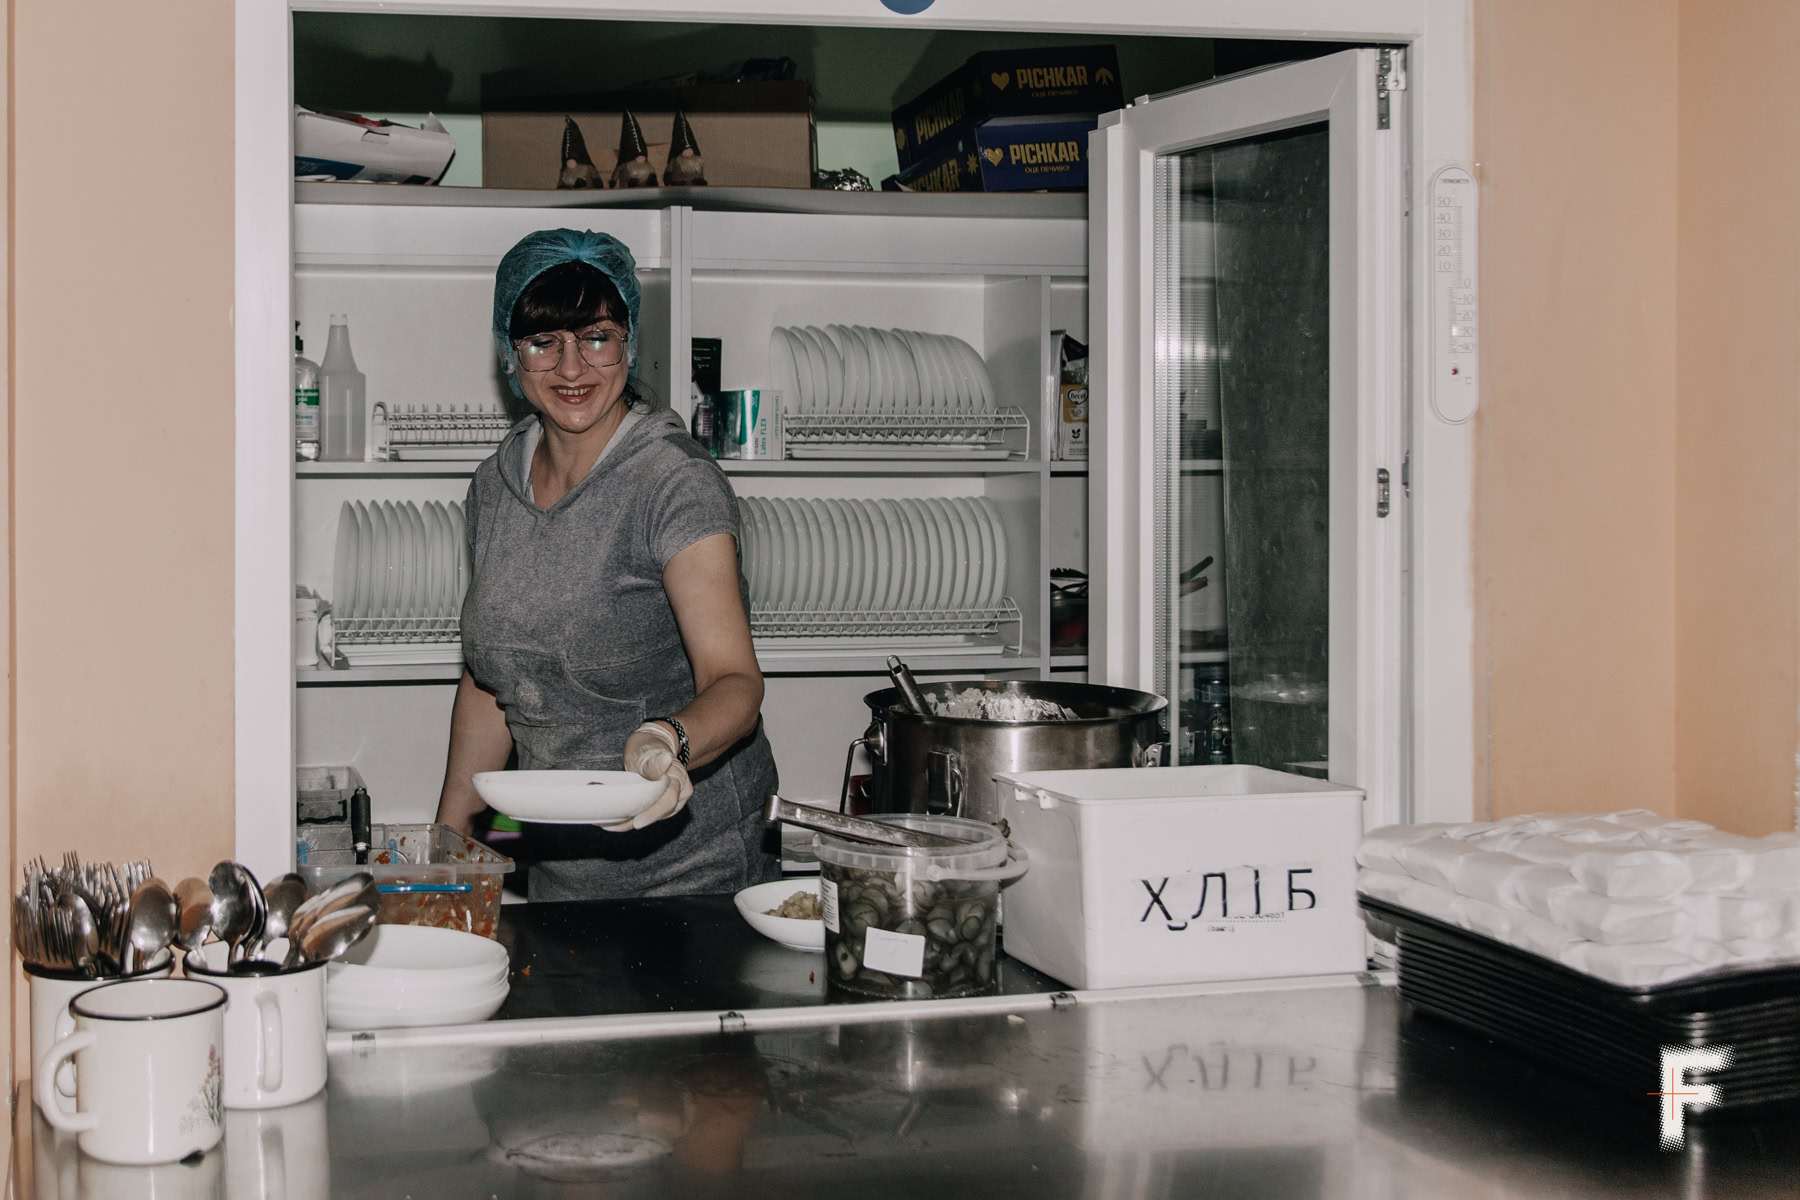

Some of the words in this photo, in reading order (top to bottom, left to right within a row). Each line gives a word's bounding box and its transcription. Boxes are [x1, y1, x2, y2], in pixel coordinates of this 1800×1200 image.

[1016, 64, 1088, 89] PICHKAR
[915, 88, 967, 145] PICHKAR
[1009, 140, 1081, 165] PICHKAR
[1024, 166, 1040, 174] ОЦЕ
[907, 159, 961, 192] CHKAR
[1437, 196, 1451, 207] 50
[1436, 213, 1451, 223] 40
[1437, 245, 1451, 255] 20
[1439, 261, 1451, 271] 10
[1464, 278, 1471, 288] 0
[1465, 376, 1472, 385] C
[1140, 868, 1316, 922] ХЛІБ
